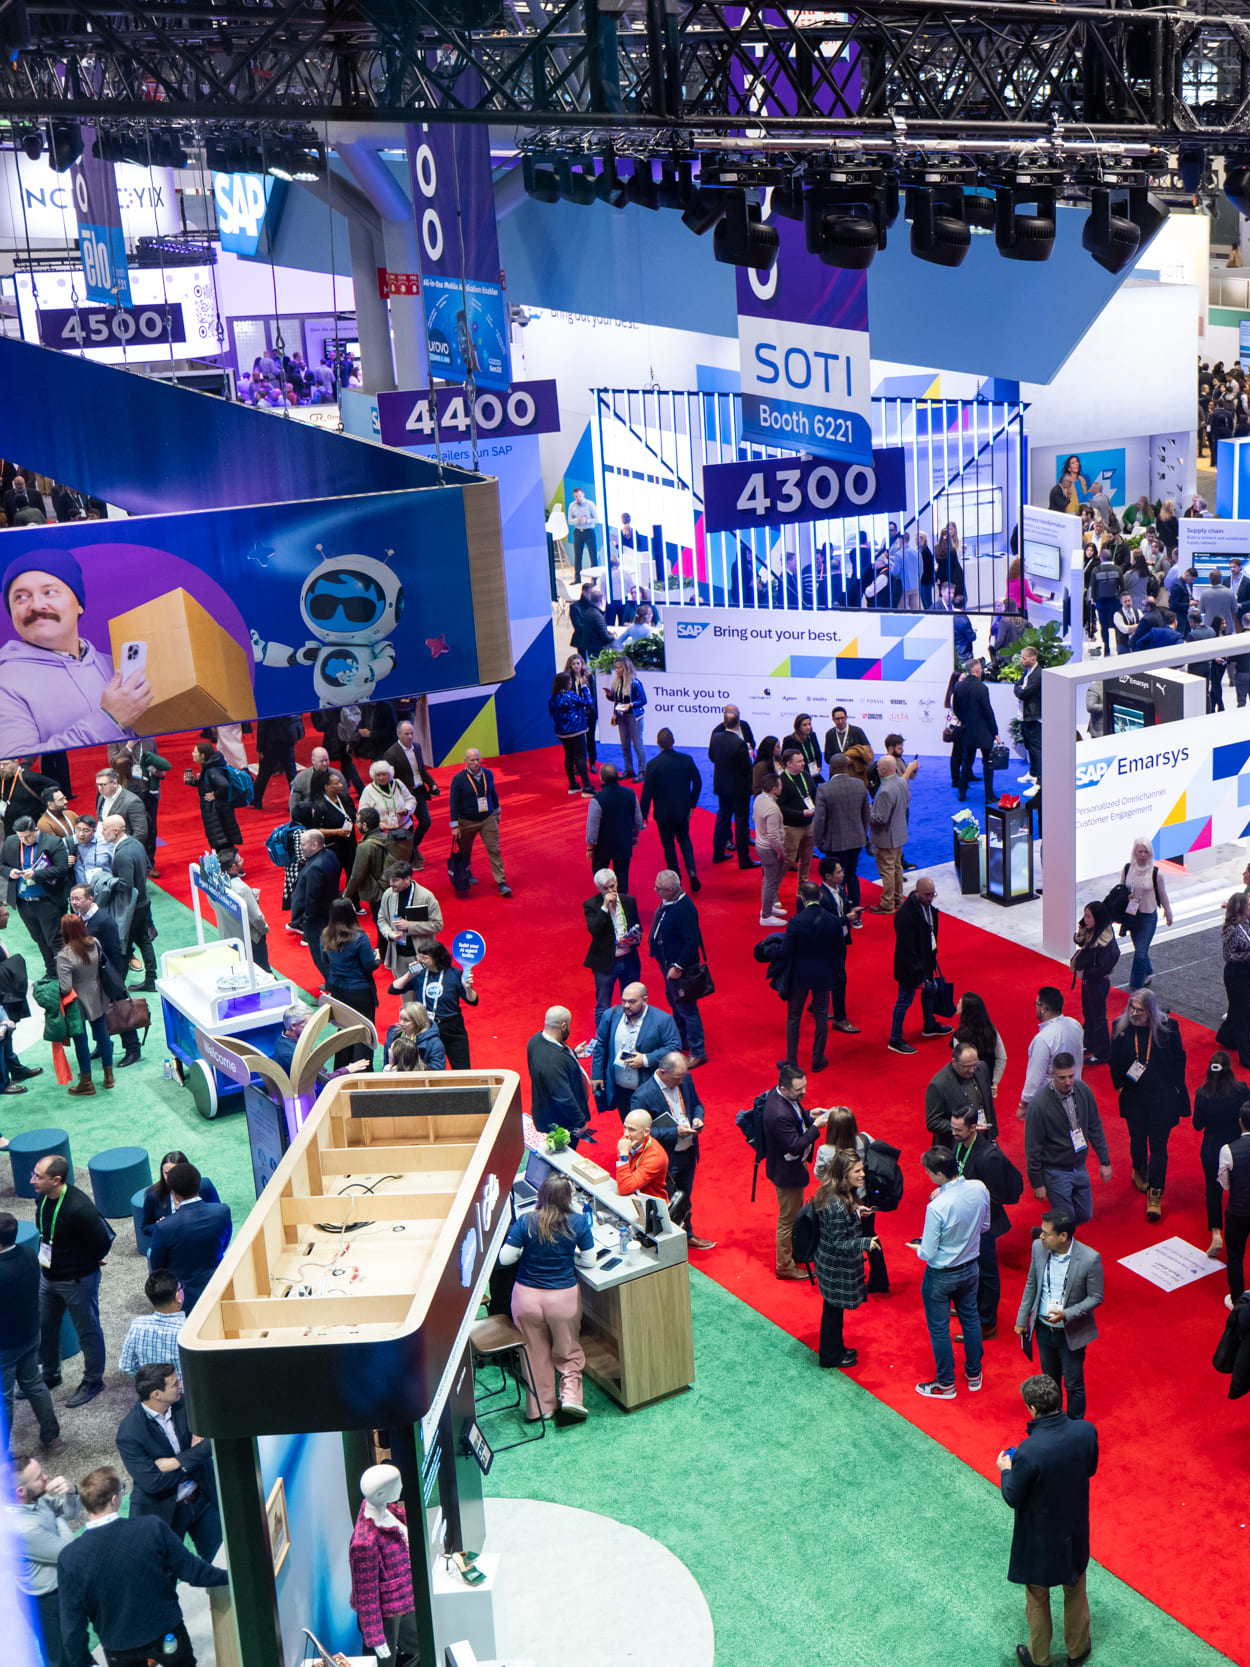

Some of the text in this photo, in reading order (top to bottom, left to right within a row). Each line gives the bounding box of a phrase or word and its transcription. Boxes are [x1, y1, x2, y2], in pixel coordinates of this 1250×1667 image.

[25, 187, 77, 209] NC
[214, 173, 267, 238] SAP
[61, 311, 163, 342] 4500
[755, 342, 853, 397] SOTI
[405, 390, 536, 435] 4400
[759, 404, 853, 443] Booth 6221
[427, 450, 470, 461] reailers
[491, 445, 513, 457] SAP
[737, 463, 878, 515] 4300
[677, 623, 842, 643] SAP Bring out your best.
[653, 686, 730, 701] Thank you to
[654, 701, 727, 715] our custome
[1075, 747, 1190, 786] SAP Emarsys
